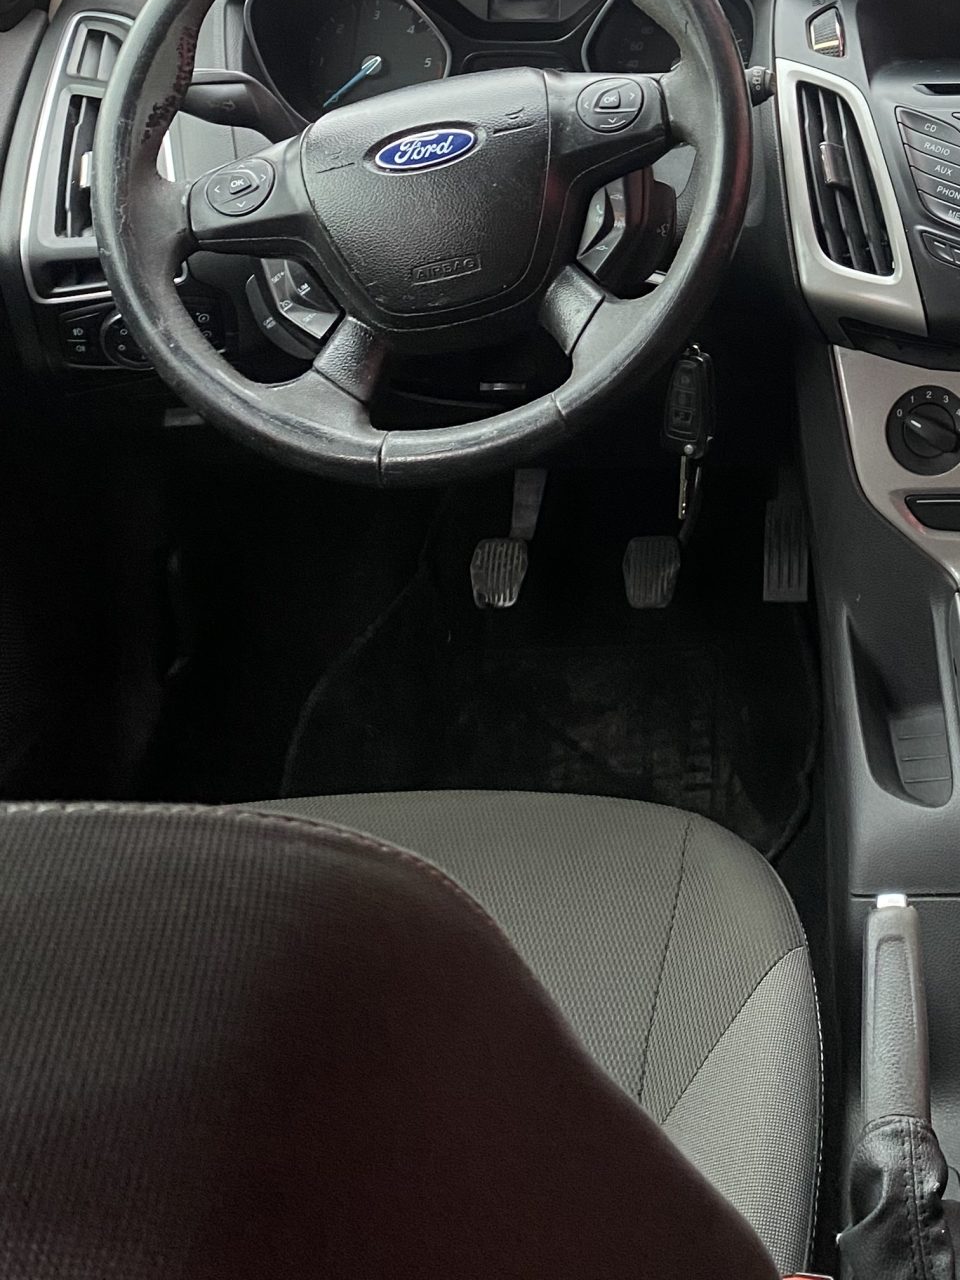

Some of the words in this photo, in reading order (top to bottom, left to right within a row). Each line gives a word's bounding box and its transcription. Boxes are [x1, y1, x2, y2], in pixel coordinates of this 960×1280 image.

[406, 24, 415, 34] 4
[424, 57, 432, 68] 5
[924, 123, 937, 132] CD
[394, 134, 454, 163] Ford
[923, 141, 950, 156] RADIO
[934, 164, 953, 176] AUX
[230, 178, 245, 188] OK
[926, 390, 932, 399] 2
[943, 394, 949, 404] 3
[896, 408, 903, 417] 0
[955, 408, 960, 416] 4
